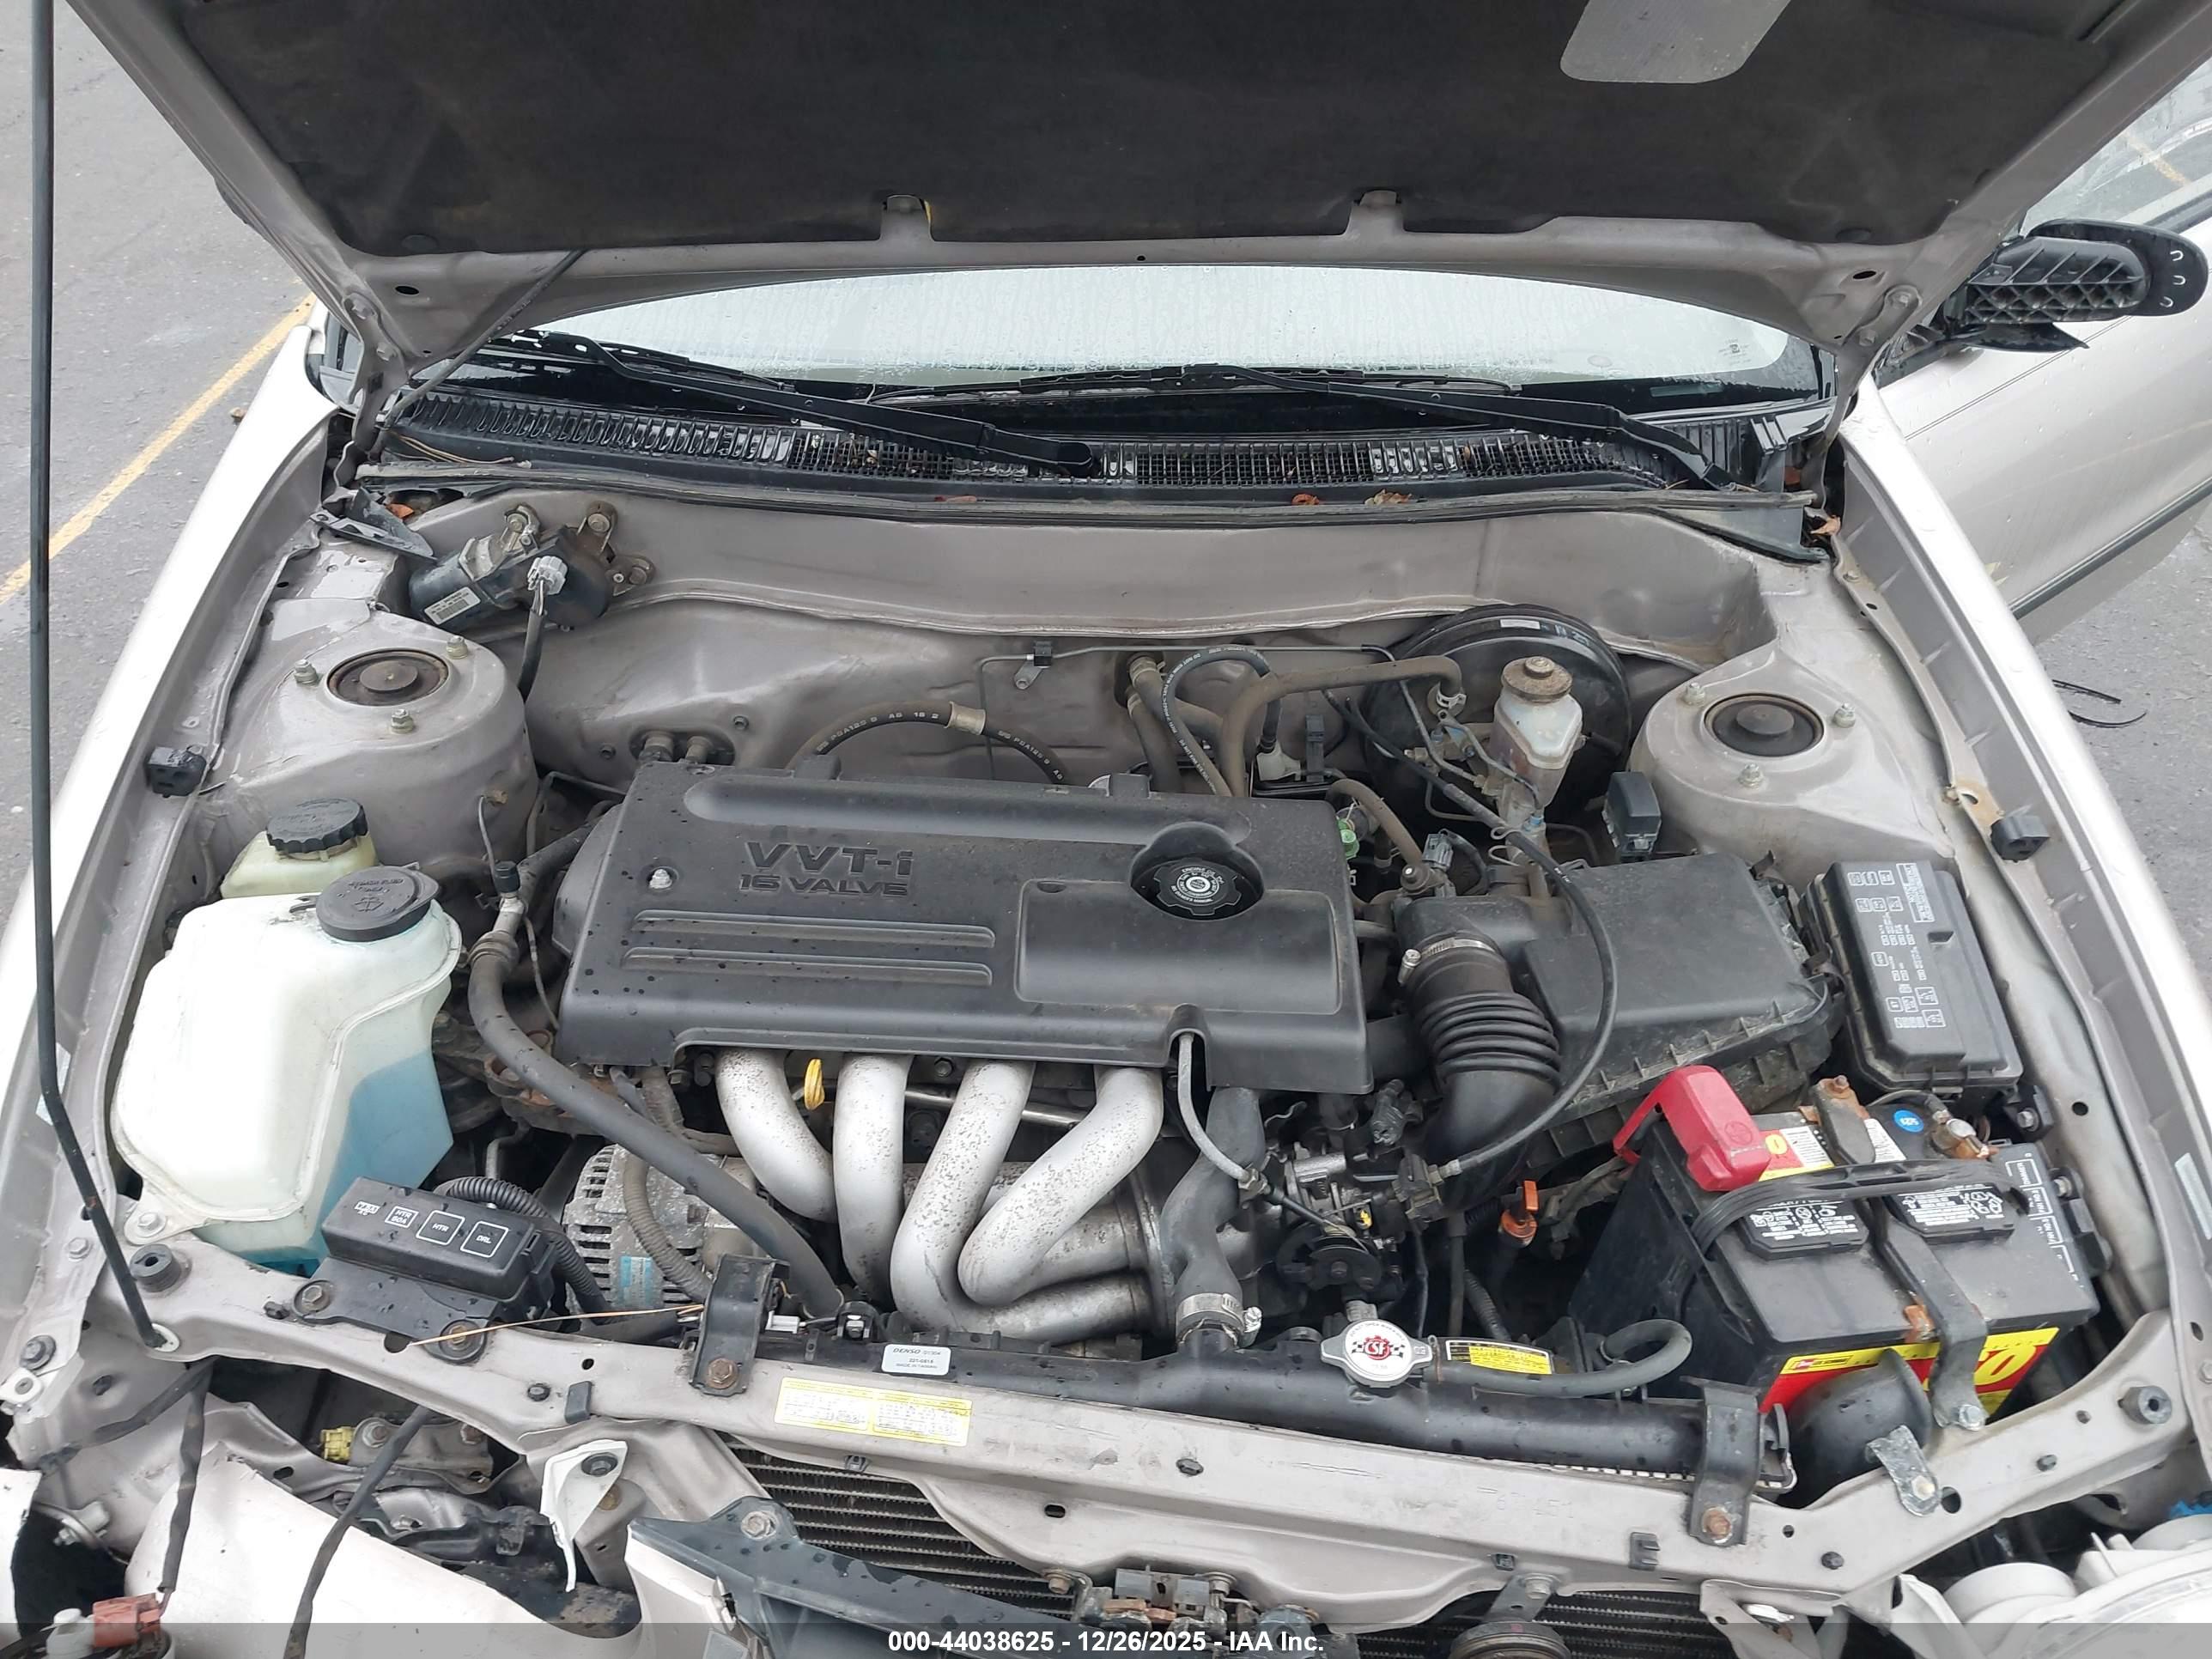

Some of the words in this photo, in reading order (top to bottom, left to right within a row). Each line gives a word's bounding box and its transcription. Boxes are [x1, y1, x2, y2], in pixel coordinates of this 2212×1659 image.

[746, 841, 914, 877] VVT-i
[739, 873, 782, 892] 16
[788, 877, 908, 897] VALVE
[432, 1223, 450, 1232] HTR
[476, 1235, 492, 1244] DRL
[1364, 1340, 1388, 1355] CSF
